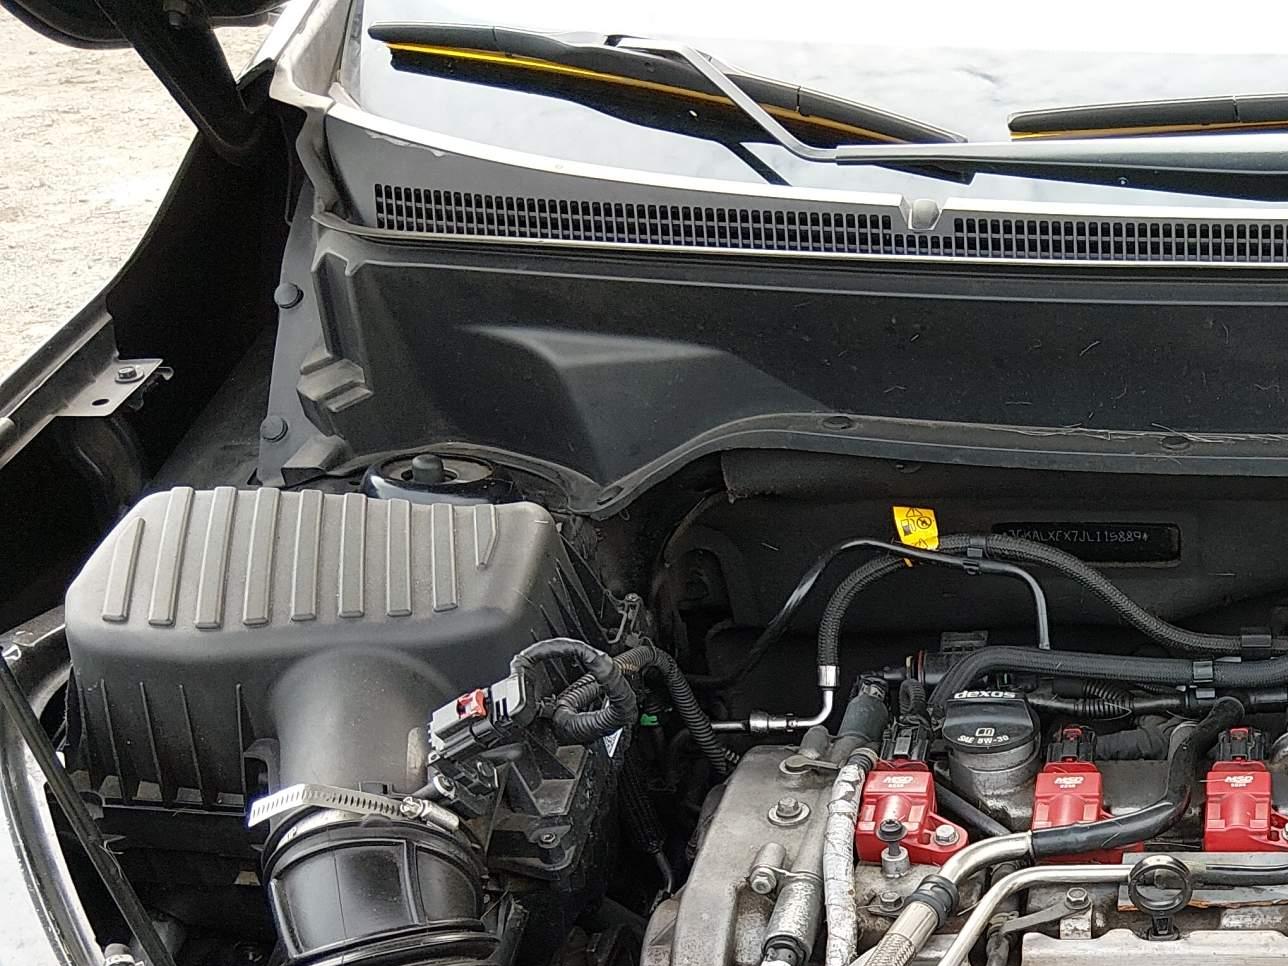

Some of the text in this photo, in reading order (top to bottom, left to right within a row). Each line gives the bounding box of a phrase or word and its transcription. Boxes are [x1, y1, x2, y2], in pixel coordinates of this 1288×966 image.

[953, 690, 1016, 699] dexos
[957, 734, 1010, 745] SAE 5W-30
